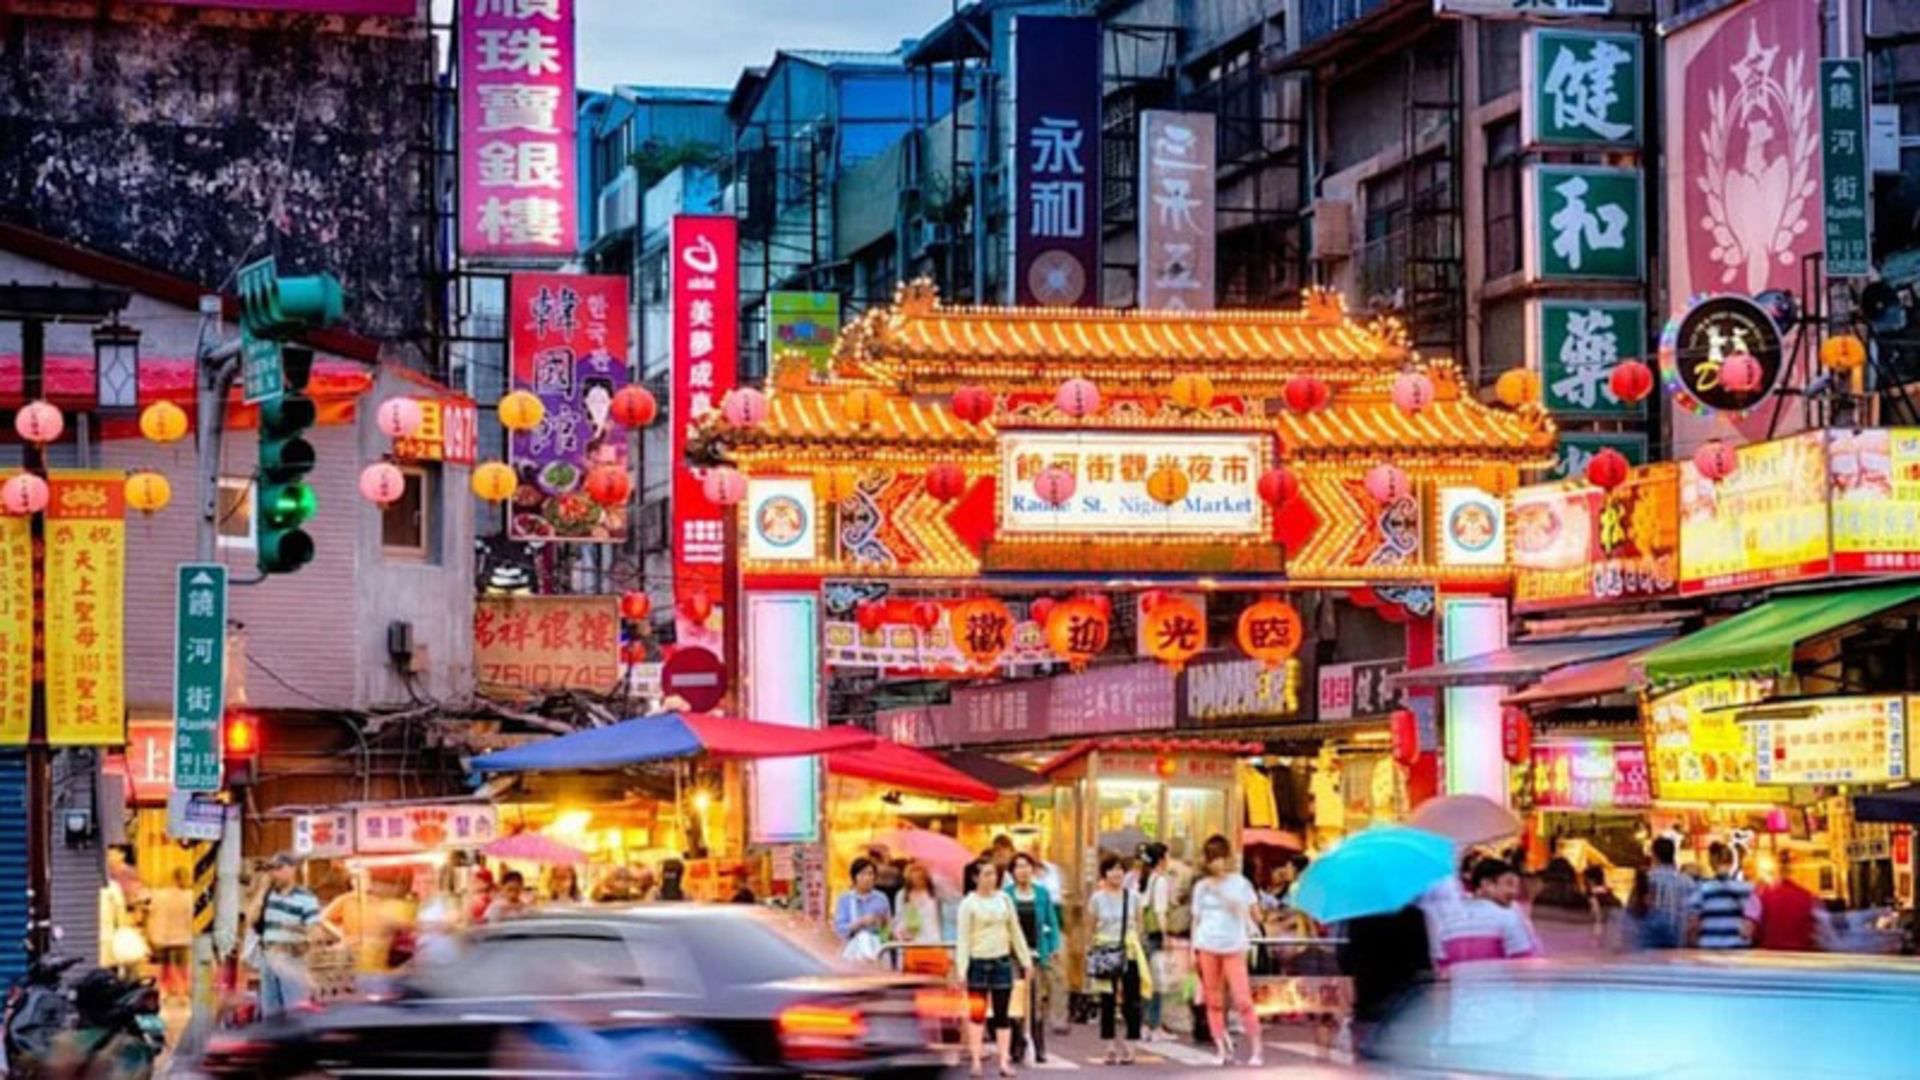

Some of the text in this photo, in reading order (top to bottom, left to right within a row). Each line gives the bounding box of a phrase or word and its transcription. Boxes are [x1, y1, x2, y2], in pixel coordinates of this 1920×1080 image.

[1544, 40, 1632, 139] 健
[1030, 117, 1084, 237] 永和
[1830, 84, 1857, 201] 饒河街
[1550, 176, 1628, 270] 和
[1082, 497, 1107, 512] St.
[1184, 497, 1251, 512] Market
[187, 589, 215, 712] 饒河街
[1067, 615, 1102, 652] 迎
[1155, 616, 1198, 650] 光
[1249, 617, 1290, 649] 臨
